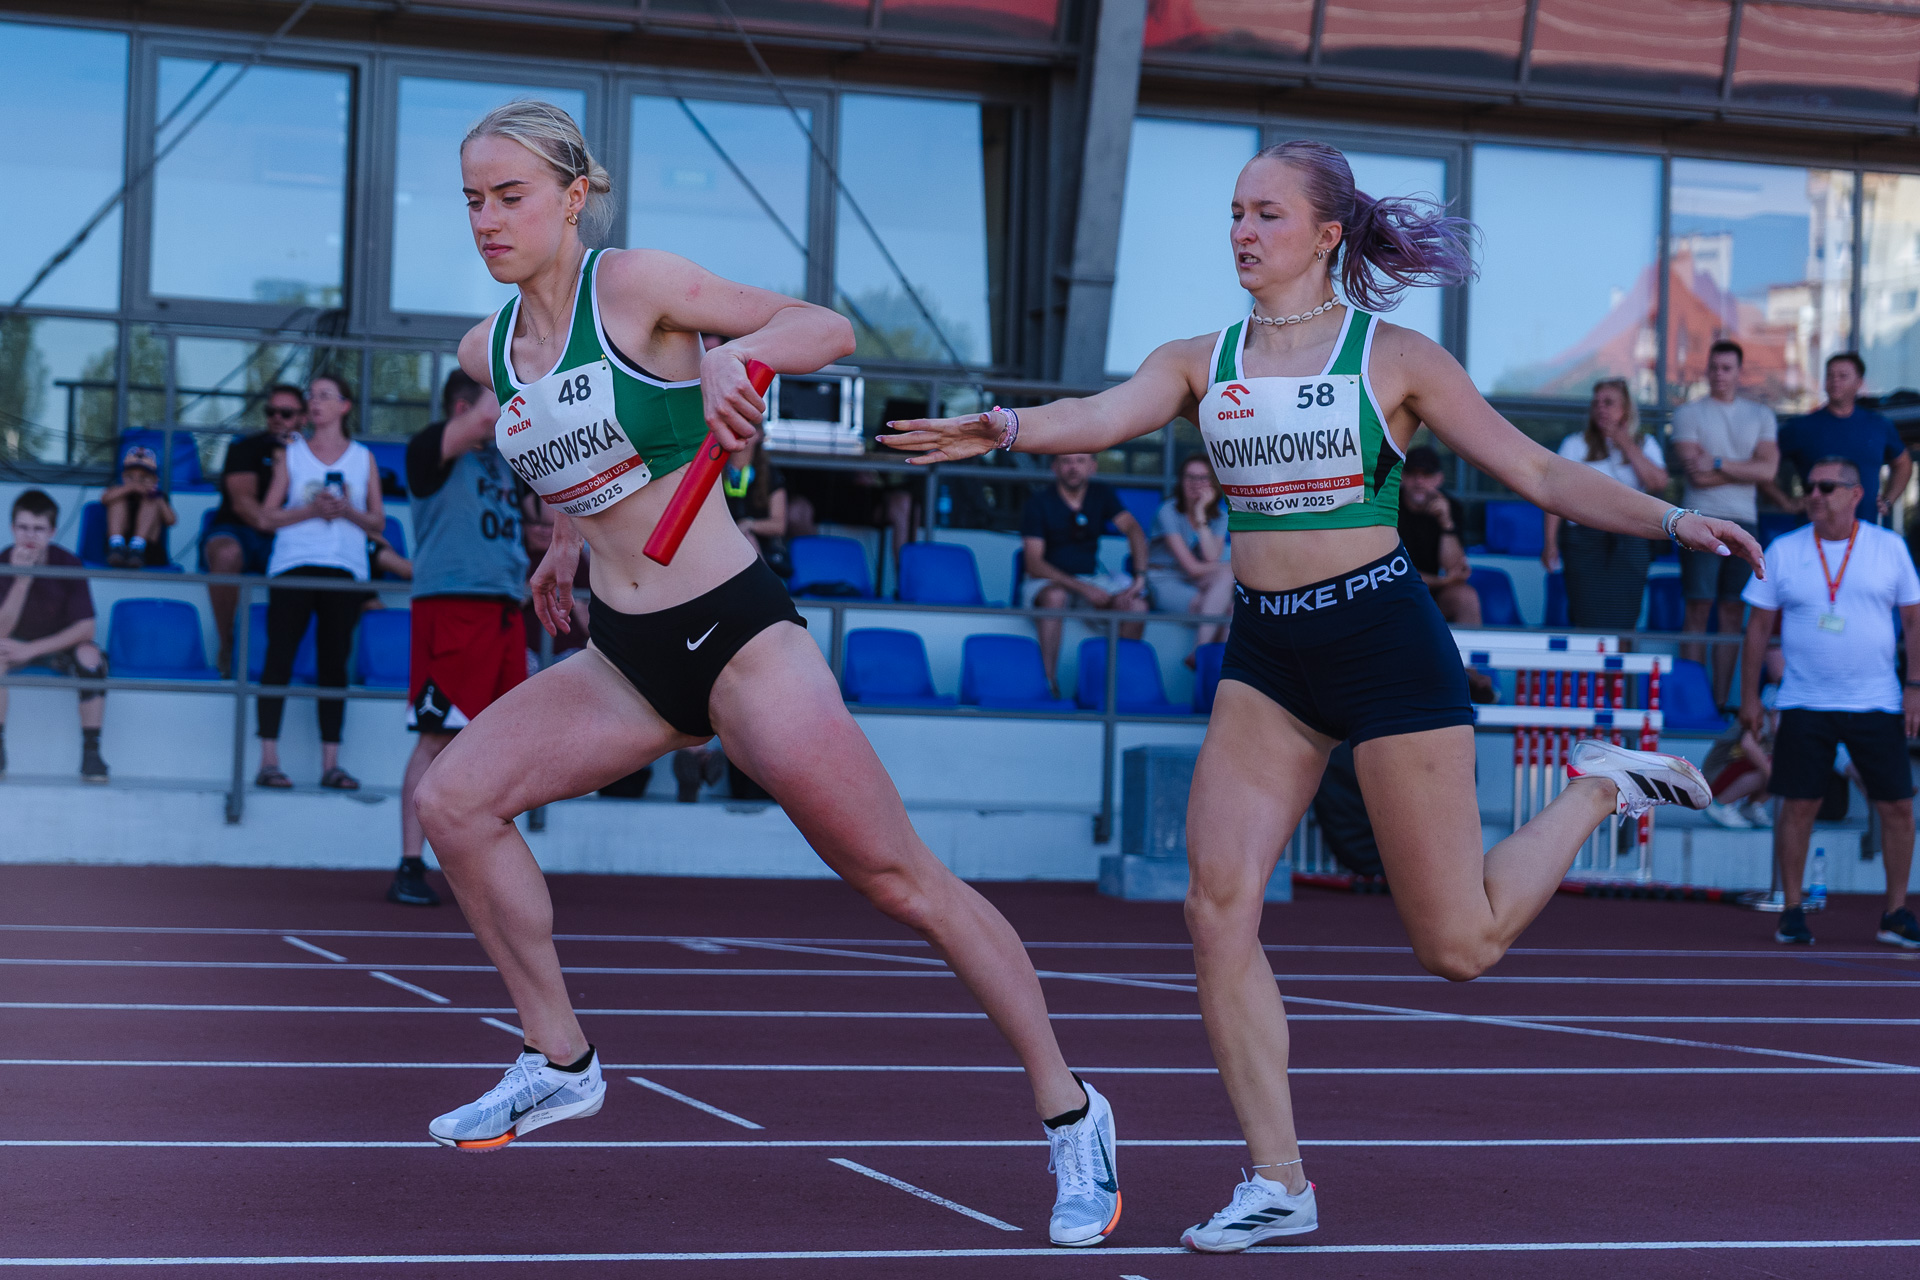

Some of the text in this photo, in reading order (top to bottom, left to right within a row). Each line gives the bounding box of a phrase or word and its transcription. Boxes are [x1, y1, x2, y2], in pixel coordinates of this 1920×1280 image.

[558, 374, 592, 406] 48
[1297, 383, 1335, 409] 58
[507, 418, 532, 437] ORLEN
[1217, 408, 1254, 421] ORLEN
[509, 418, 625, 482] BORKOWSKA
[1210, 427, 1357, 469] NOWAKOWSKA
[588, 471, 613, 489] Polski
[613, 462, 630, 475] U23
[1240, 487, 1255, 495] PZLA
[1255, 483, 1306, 495] Mistrzostwa
[1307, 480, 1332, 490] Polski
[1333, 477, 1351, 487] U23
[563, 483, 623, 515] KRAKÓW 2025
[1245, 495, 1335, 512] KRAKÓW 2025
[1260, 556, 1408, 616] NIKE PRO
